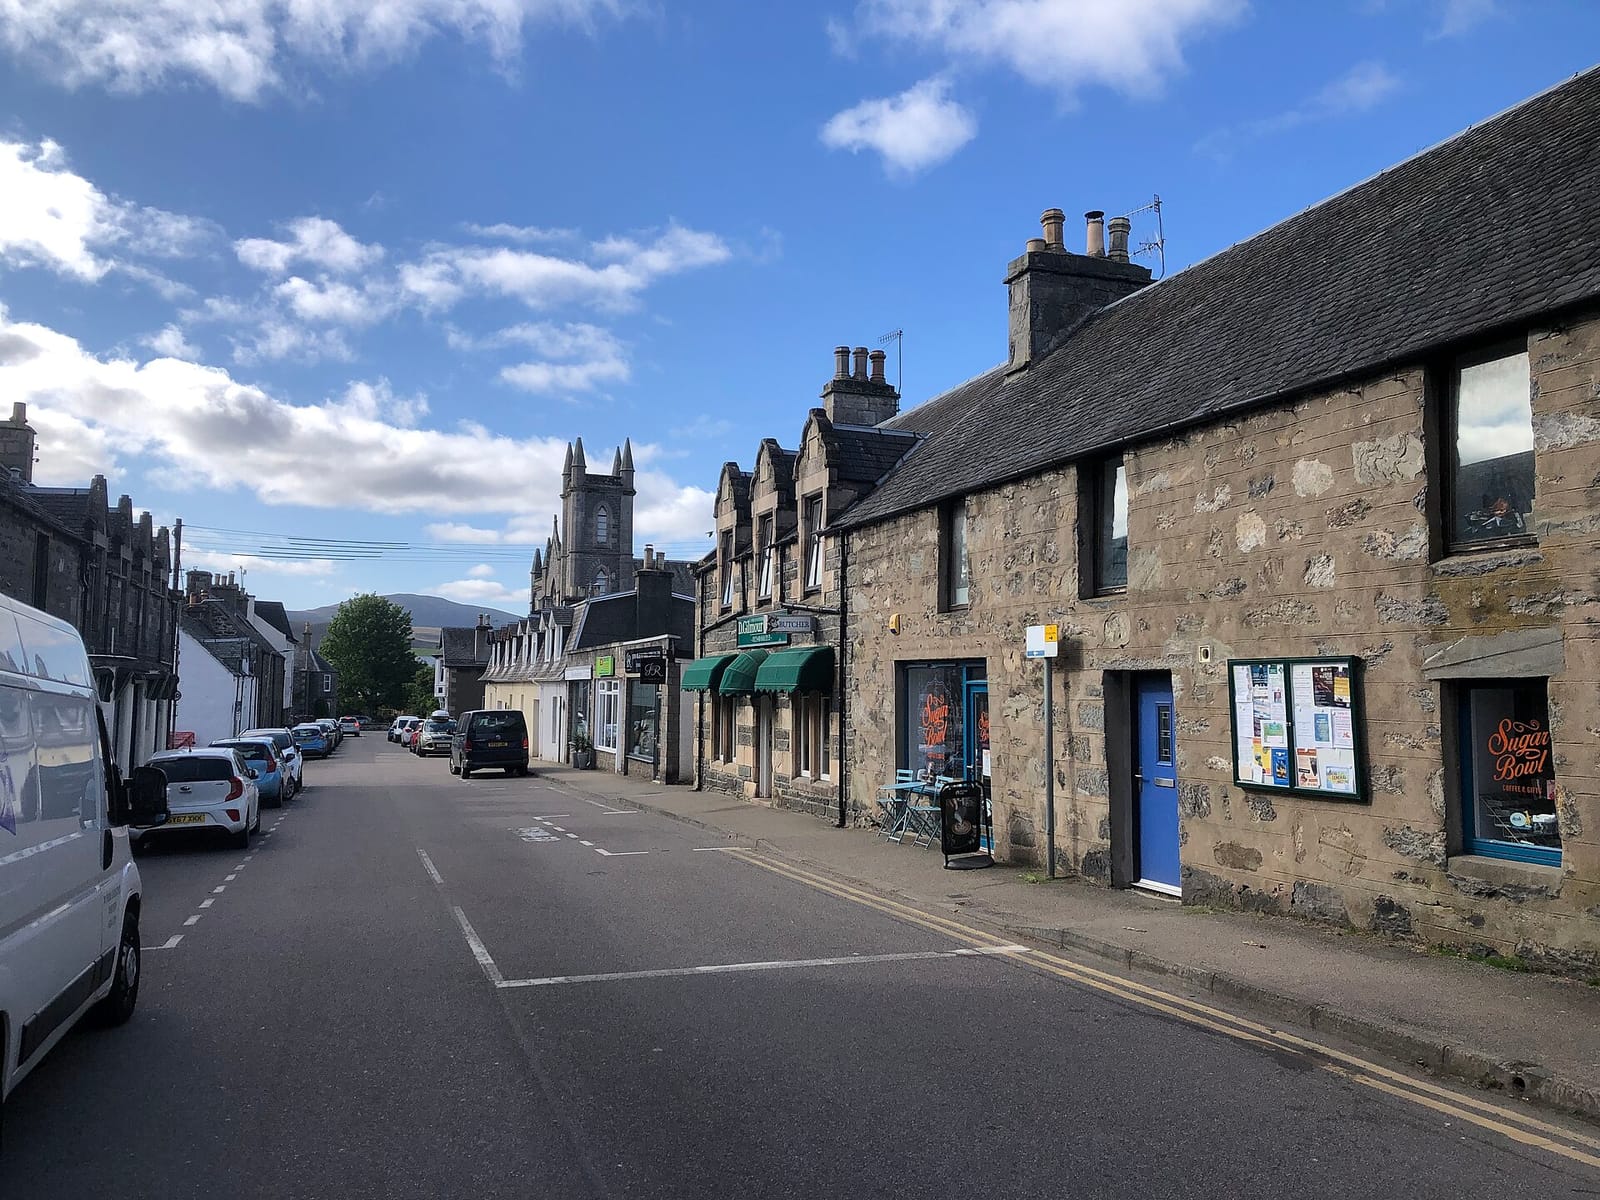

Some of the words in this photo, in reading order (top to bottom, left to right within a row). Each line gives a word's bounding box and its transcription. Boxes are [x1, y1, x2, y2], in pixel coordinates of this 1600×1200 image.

[922, 693, 948, 729] Sugar
[926, 720, 948, 747] Bowl
[1488, 718, 1549, 759] Sugar
[1493, 750, 1548, 781] Bowl
[1502, 784, 1521, 793] COFFEE
